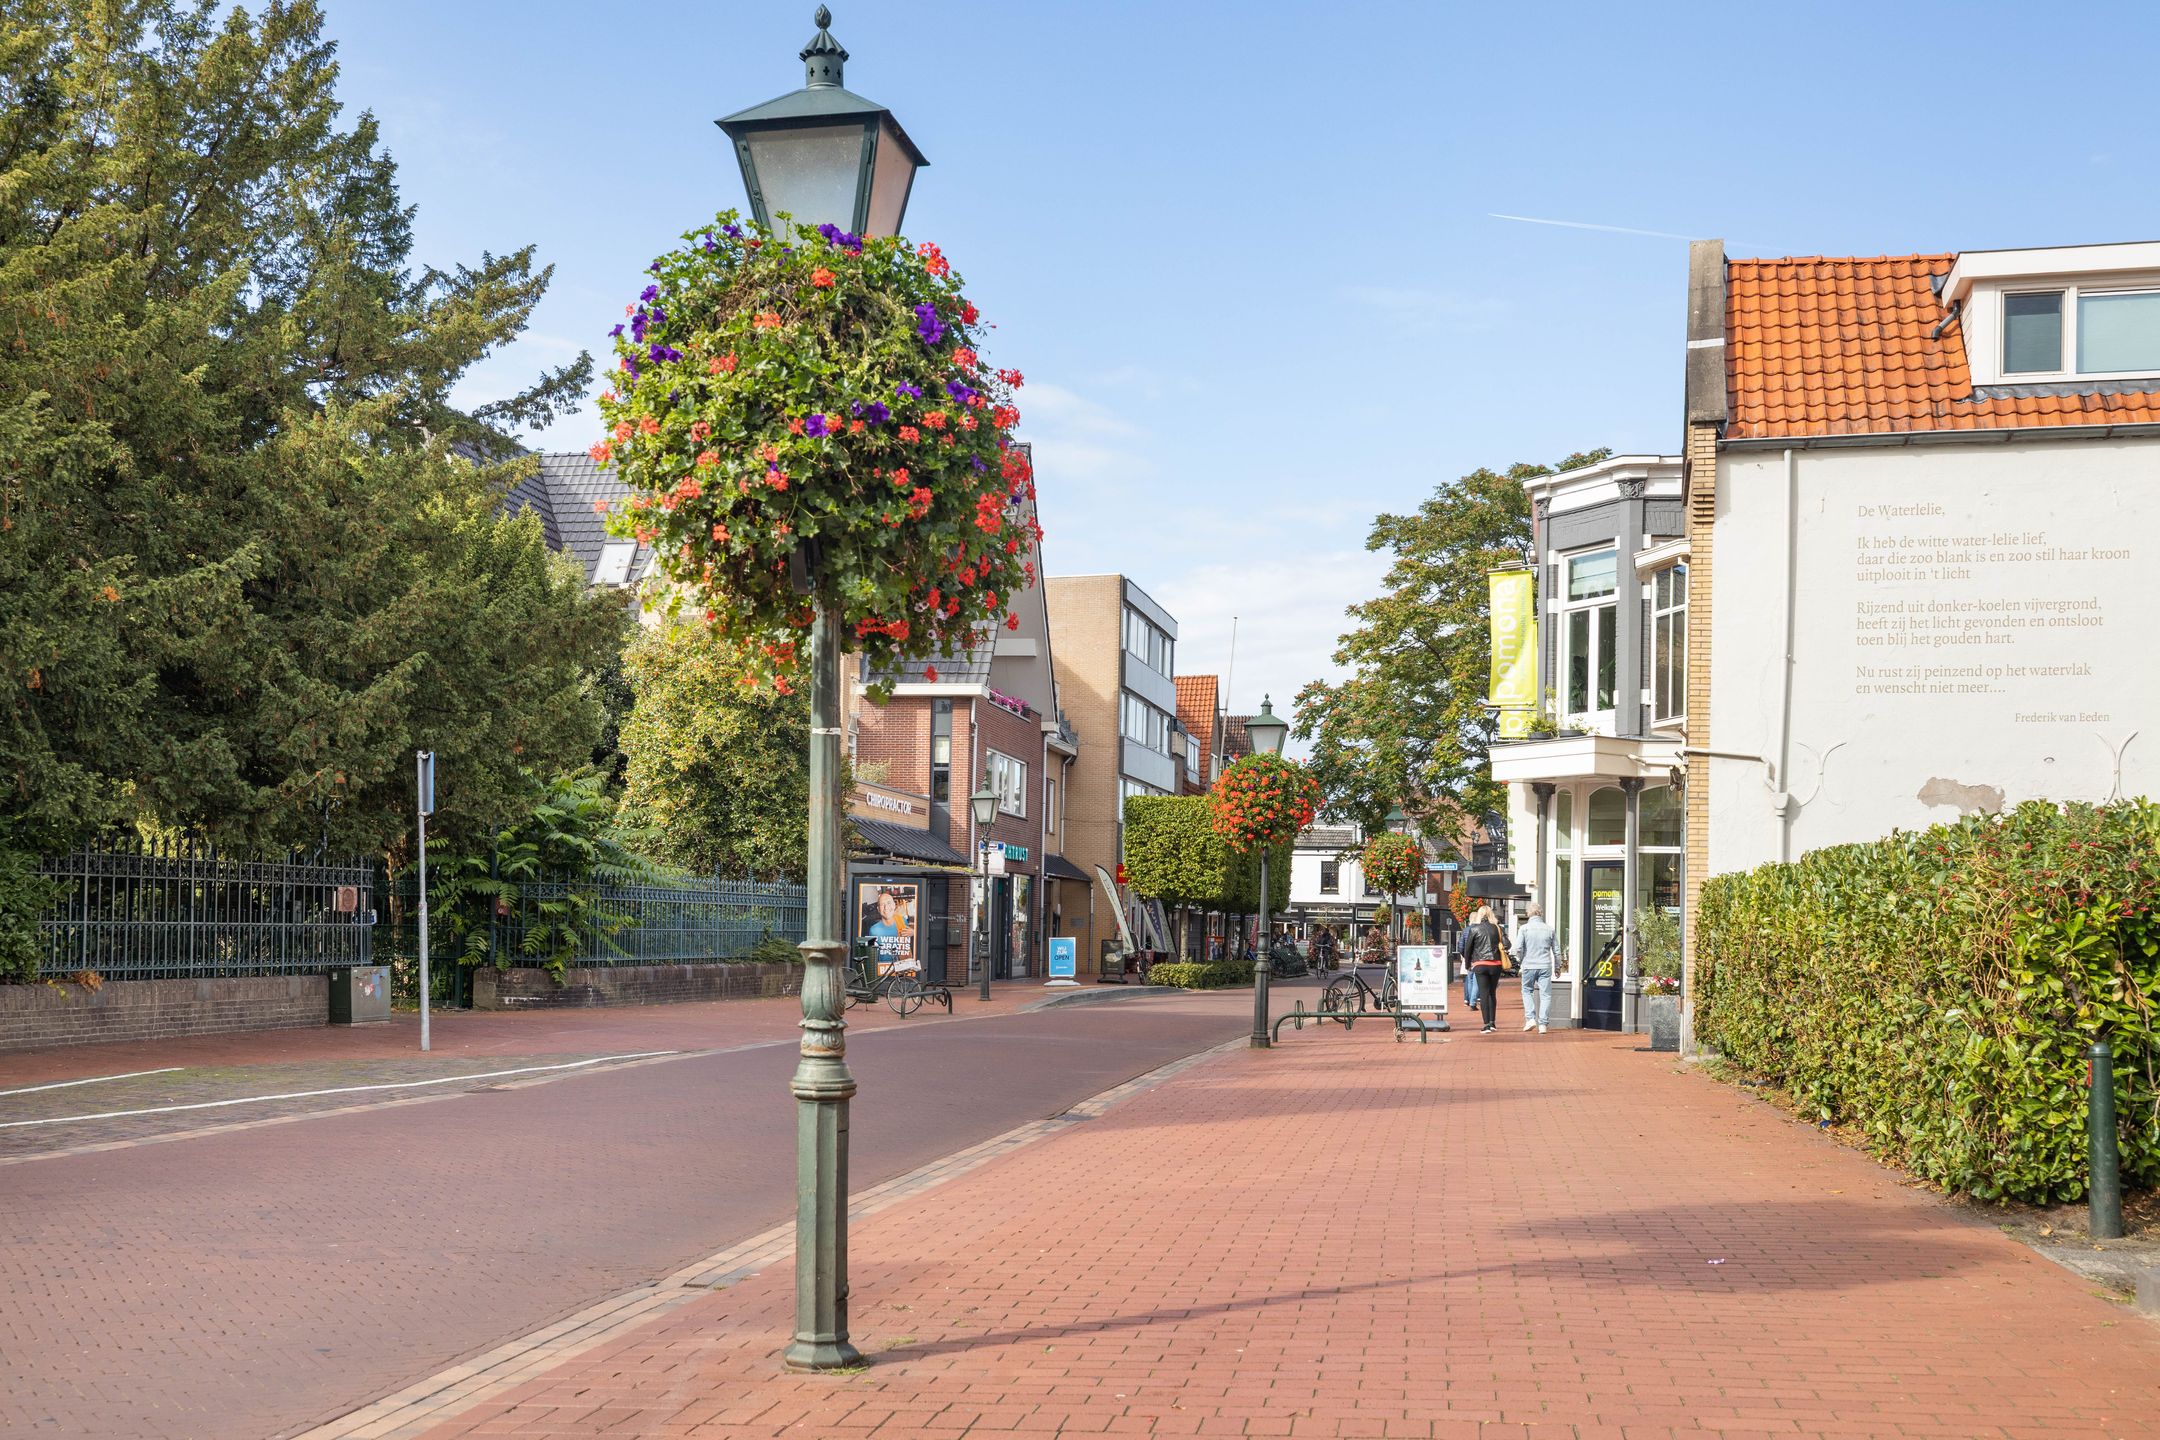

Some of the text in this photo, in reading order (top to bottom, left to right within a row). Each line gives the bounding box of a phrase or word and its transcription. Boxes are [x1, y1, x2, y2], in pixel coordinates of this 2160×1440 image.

[1857, 506, 1875, 517] De
[1858, 536, 1869, 549] Ik
[1873, 536, 1896, 548] heb
[1899, 536, 1914, 548] de
[1917, 536, 1948, 547] witte
[1952, 533, 2019, 546] water-lelie
[1857, 547, 2130, 566] daar die zoo blank is en zoo stil haar kroon
[1857, 568, 1911, 584] uitplooit
[1914, 568, 1926, 580] in
[1941, 567, 1971, 579] licht
[1857, 600, 1904, 616] Rijzend
[1908, 601, 1924, 613] uit
[1928, 599, 2020, 612] donker-koelen
[1857, 614, 2103, 633] heeft zij het licht gevonden en ontsloot
[1495, 578, 1523, 699] pomona
[1856, 636, 1883, 646] toen
[1888, 633, 1906, 648] blij
[1911, 633, 1931, 645] het
[1934, 632, 1981, 648] gouden
[1857, 662, 2091, 682] Nu rust zij peinzend op het watervlak
[1856, 685, 1872, 694] en
[1874, 681, 1926, 693] wenscht
[1930, 681, 1954, 693] niet
[2015, 712, 2057, 722] Frederik
[2079, 712, 2109, 722] Eeden
[867, 792, 912, 815] CHIROPRACTOR
[1592, 890, 1620, 900] pomona
[1598, 961, 1613, 977] 93
